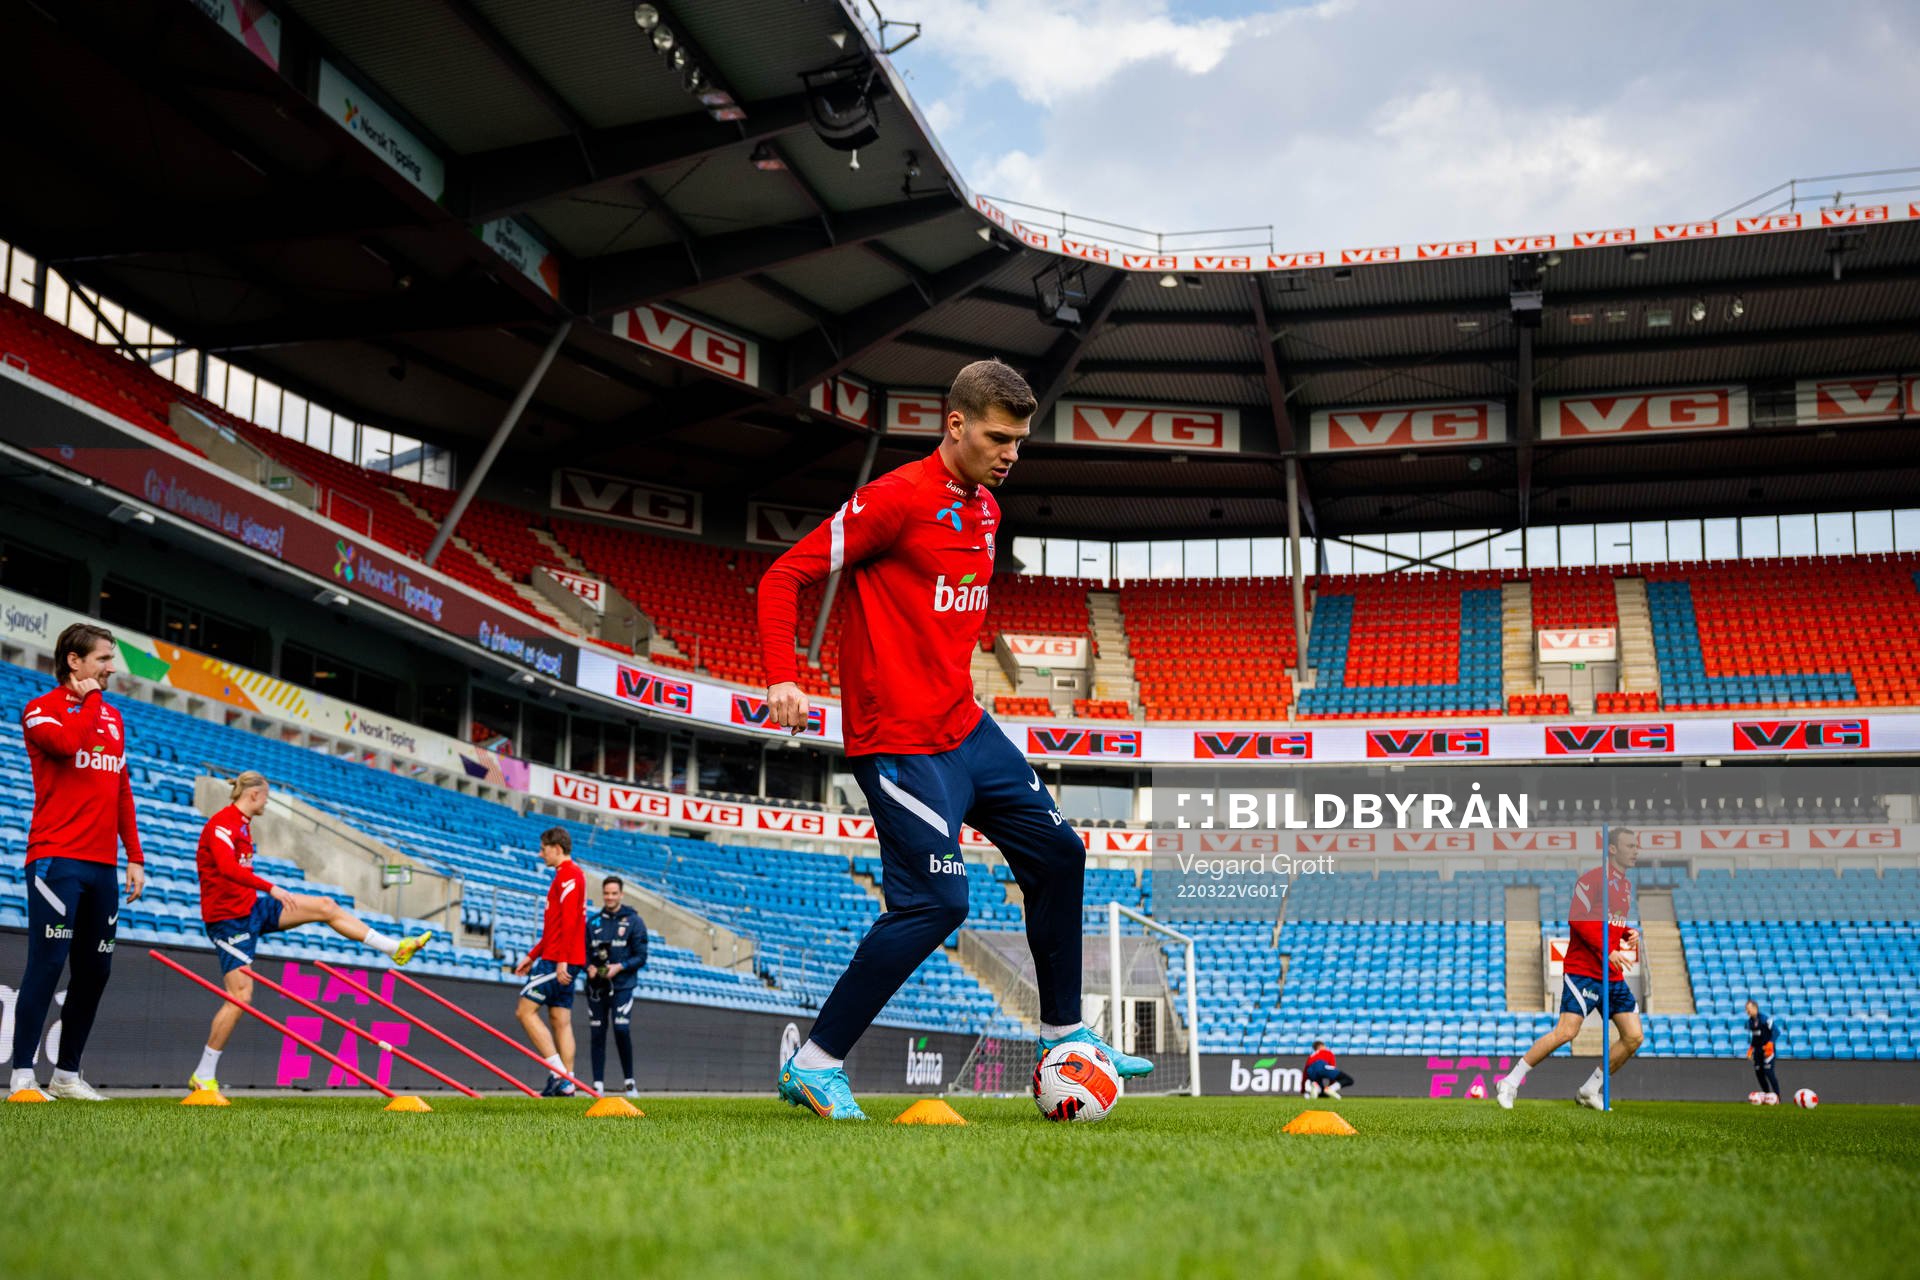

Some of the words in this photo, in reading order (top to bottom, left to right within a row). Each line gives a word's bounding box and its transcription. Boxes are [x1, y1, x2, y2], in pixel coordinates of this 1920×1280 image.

[1740, 215, 1800, 232] VG
[1824, 207, 1886, 225] VG
[1014, 221, 1046, 247] VG
[1577, 229, 1634, 246] VG
[1658, 222, 1715, 239] VG
[1065, 241, 1107, 263] VG
[1345, 248, 1398, 263] VG
[1421, 242, 1475, 258] VG
[1498, 236, 1553, 254] VG
[1126, 256, 1175, 269] VG
[1197, 257, 1249, 269] VG
[1271, 252, 1322, 268] VG
[635, 306, 740, 376] VG
[1820, 380, 1920, 416] V
[1565, 393, 1719, 432] VG
[1079, 408, 1215, 445] VG
[1332, 408, 1478, 445] VG
[568, 474, 686, 525] VG
[761, 508, 830, 541] V
[358, 556, 397, 596] Norsk
[398, 575, 444, 622] Tipping
[5, 604, 49, 638] sjanse!
[1013, 638, 1073, 655] VG
[1543, 632, 1610, 648] VG
[620, 670, 689, 711] VG
[360, 720, 383, 739] Norsk
[385, 725, 416, 753] Tipping
[1031, 730, 1136, 756] VG
[1200, 732, 1306, 757] VG
[1373, 730, 1484, 757] VG
[1549, 725, 1667, 750] VG
[1736, 721, 1862, 749] VG
[555, 776, 597, 803] VG
[611, 789, 668, 816] VG
[684, 800, 741, 826] VG
[759, 810, 823, 834] VG
[840, 819, 878, 838] V
[1109, 832, 1182, 850] VG
[1202, 834, 1277, 852] VG
[1297, 833, 1374, 851] VG
[1396, 832, 1473, 850] VG
[1495, 831, 1575, 849] VG
[1703, 830, 1788, 848] VG
[1812, 829, 1899, 847] VG
[45, 924, 74, 939] bam
[906, 1037, 943, 1085] bama
[1230, 1058, 1308, 1092] bam
